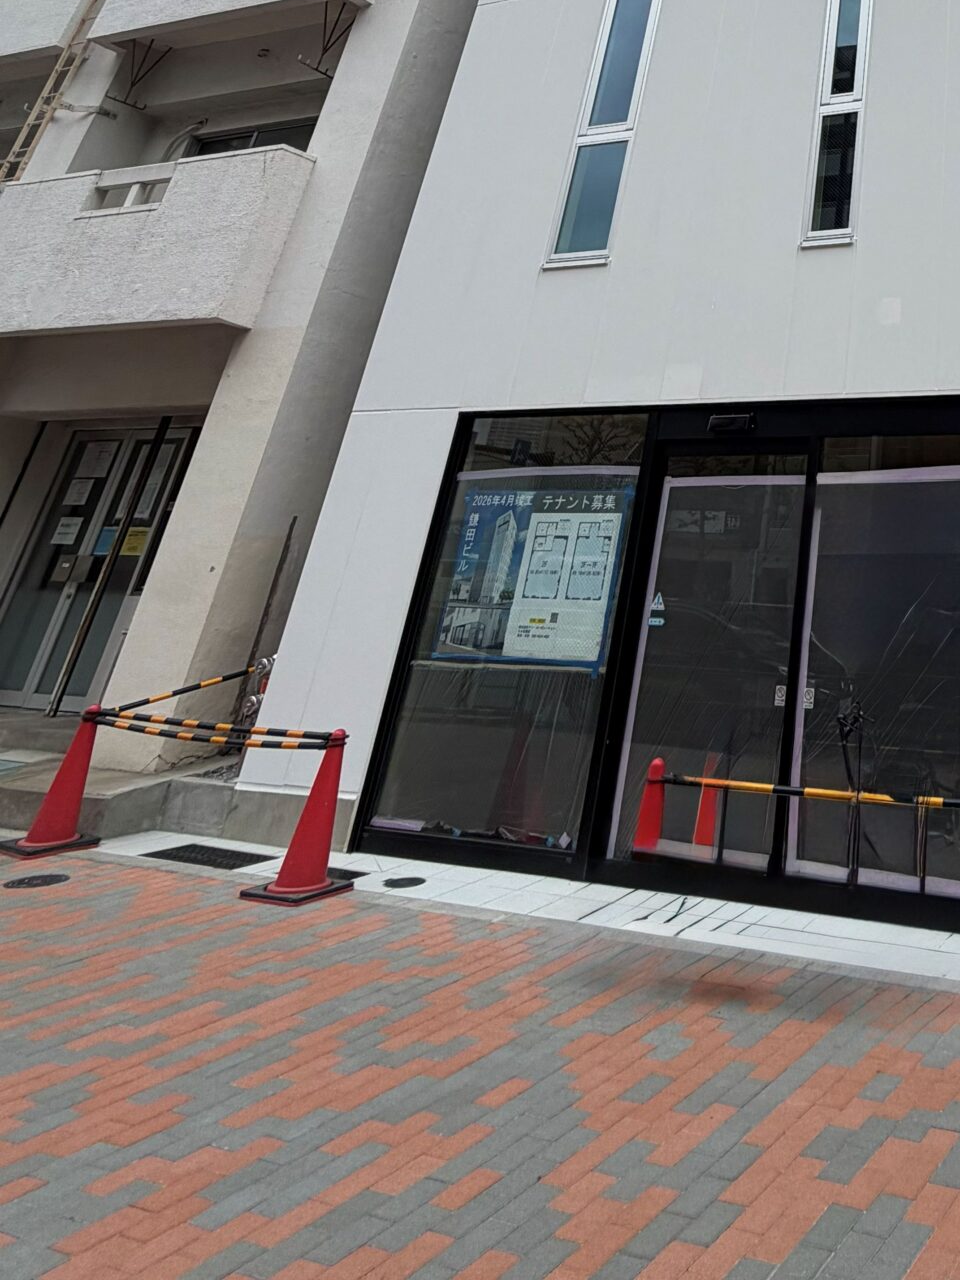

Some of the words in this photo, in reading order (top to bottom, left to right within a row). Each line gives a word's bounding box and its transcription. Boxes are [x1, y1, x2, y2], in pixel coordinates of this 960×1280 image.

[472, 495, 534, 507] 2026年4月竣工
[542, 495, 616, 510] テナント募集
